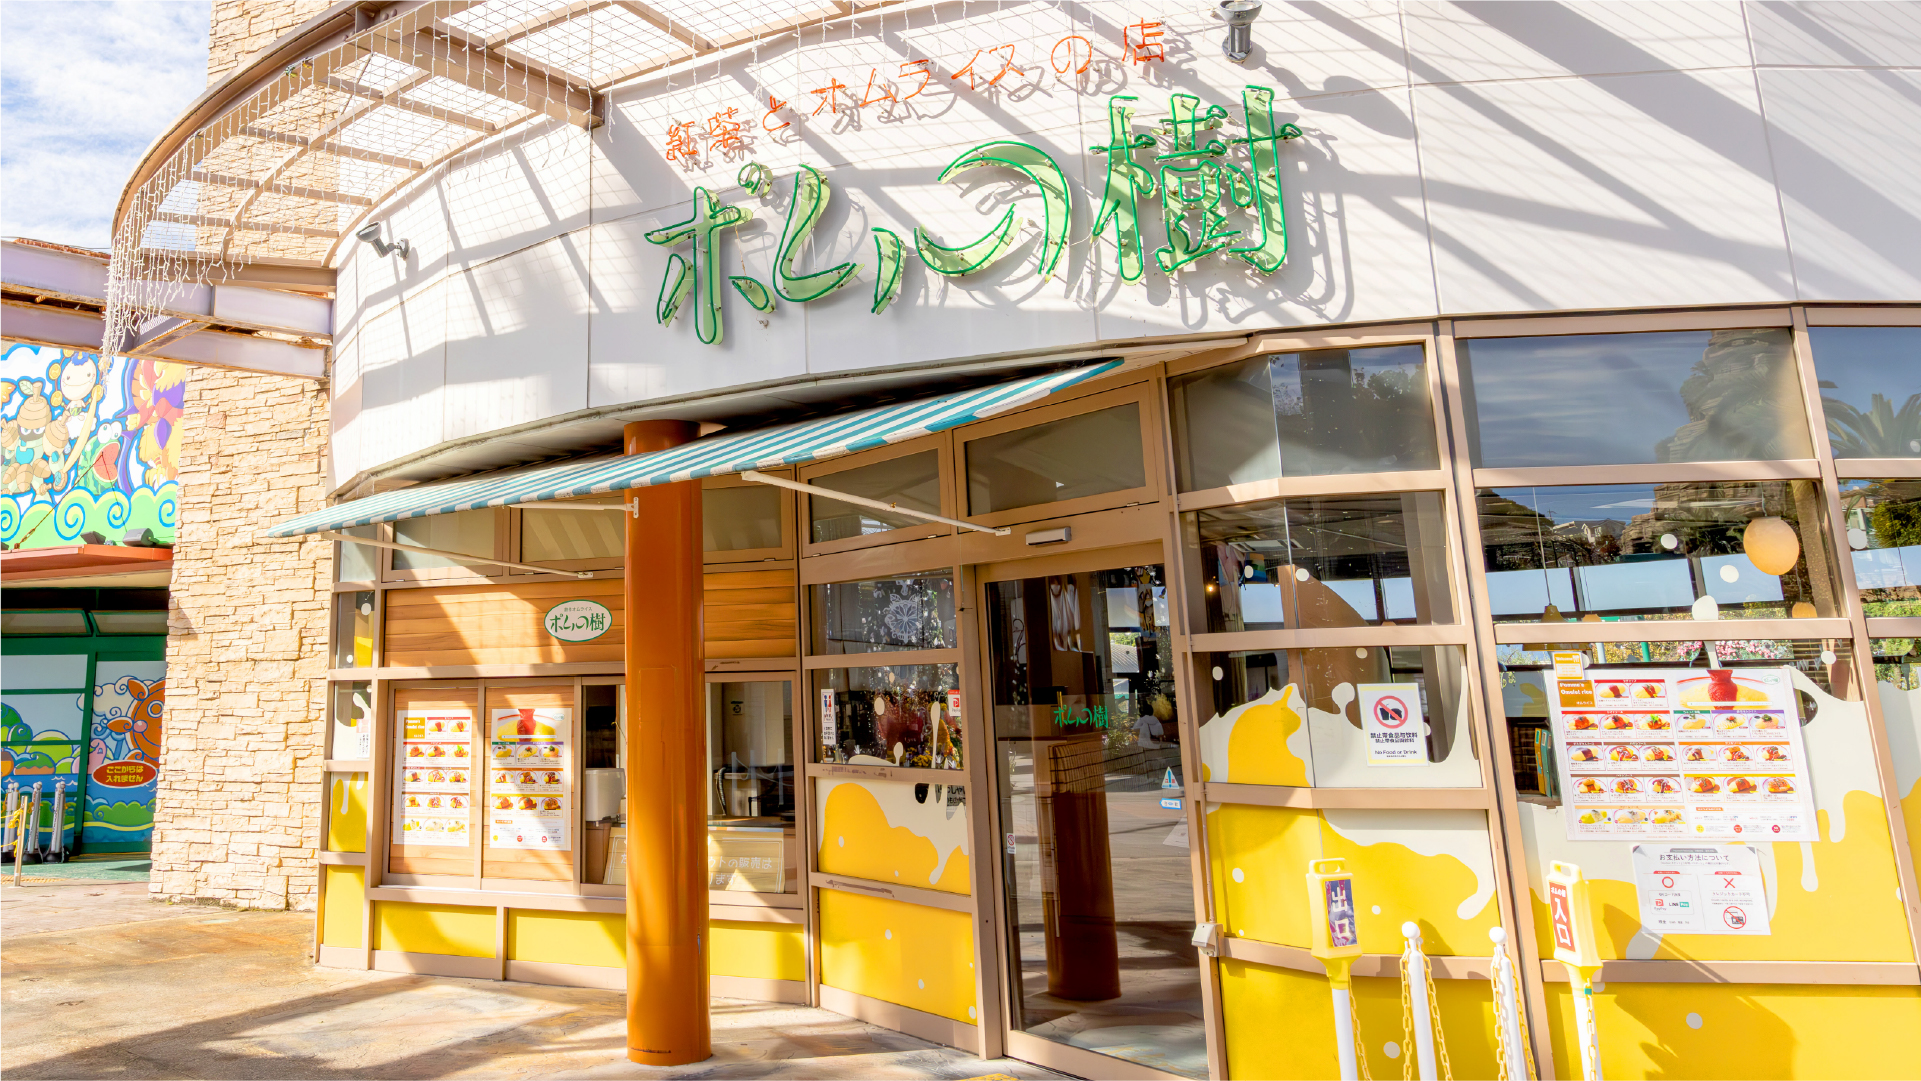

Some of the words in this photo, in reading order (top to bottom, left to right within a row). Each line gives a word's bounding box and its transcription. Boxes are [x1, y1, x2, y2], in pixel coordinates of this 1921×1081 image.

[665, 17, 1166, 162] 紅茶とオムライスの店
[105, 775, 144, 783] 入れません
[106, 765, 144, 774] ここからは
[1659, 854, 1730, 862] お支払い方法について
[1331, 886, 1351, 938] 出口
[1554, 897, 1571, 947] 入口
